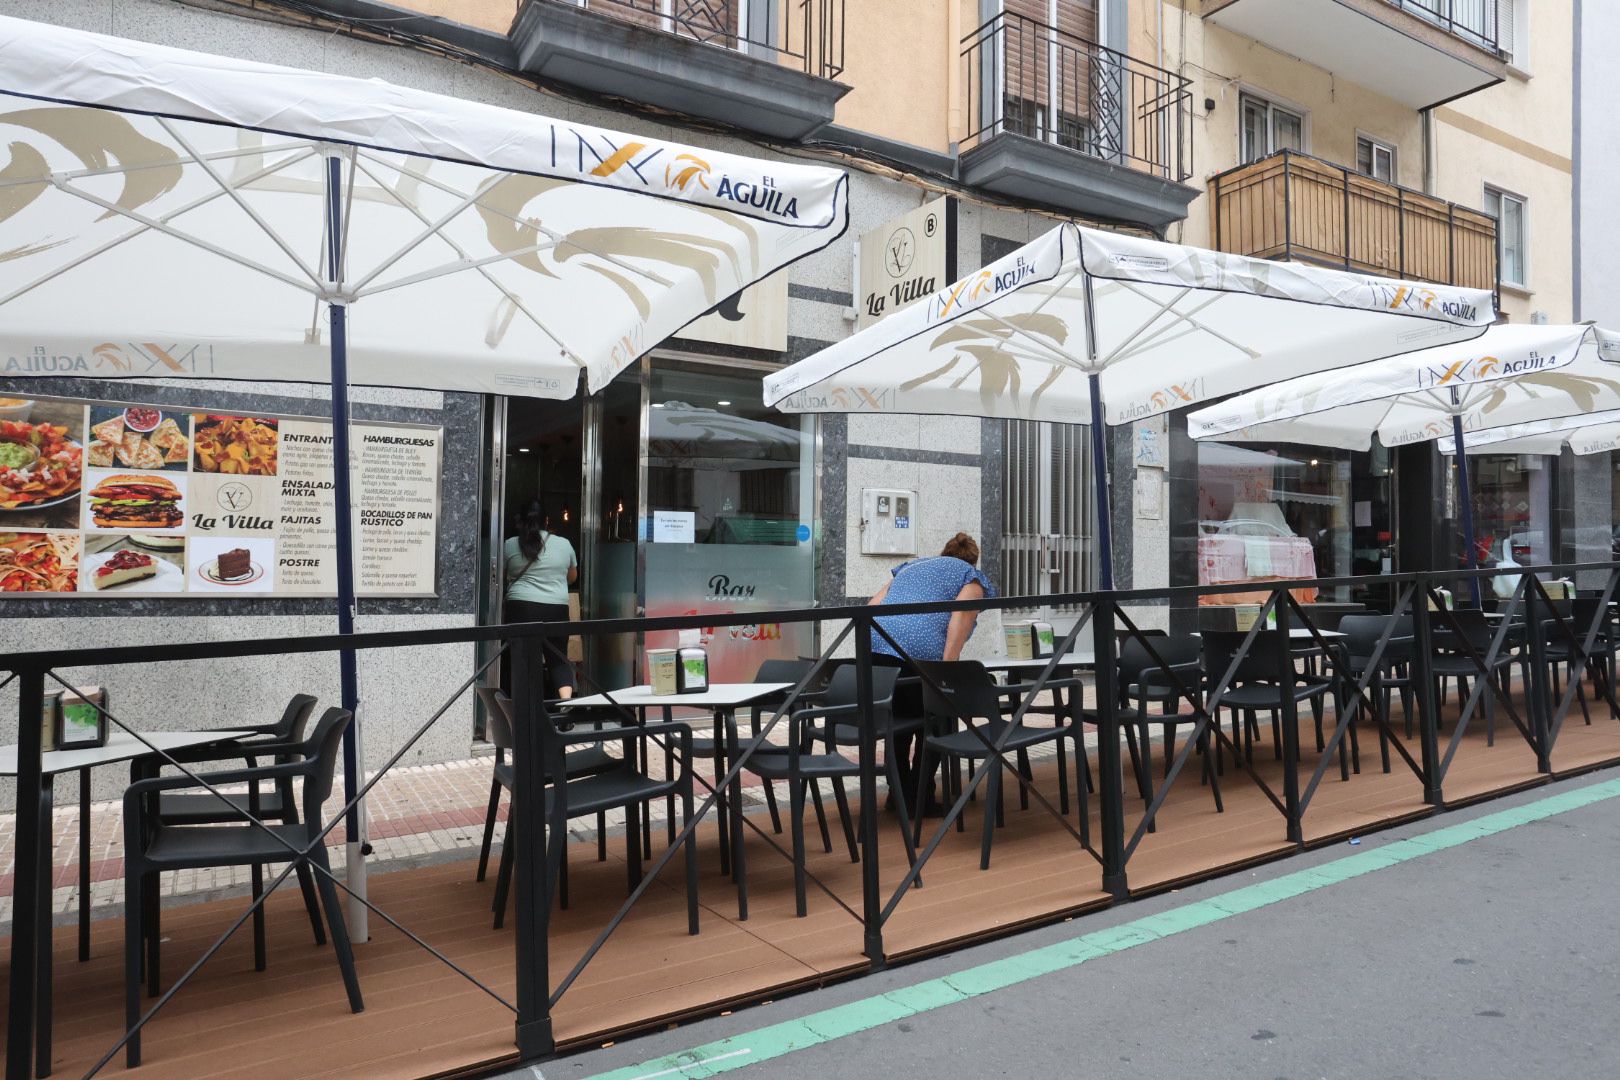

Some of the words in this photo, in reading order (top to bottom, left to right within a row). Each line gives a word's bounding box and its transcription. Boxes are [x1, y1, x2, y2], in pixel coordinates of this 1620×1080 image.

[762, 175, 777, 189] EL
[716, 174, 799, 219] ÁGUILA
[927, 218, 934, 233] B
[1017, 256, 1026, 267] EL
[866, 292, 885, 317] La
[890, 275, 936, 306] Villa
[283, 433, 334, 445] ENTRANT
[363, 434, 435, 447] HAMBURGUESAS
[281, 488, 316, 497] MIXTA
[280, 515, 322, 525] FAJITAS
[360, 509, 405, 519] BOCADILLOS
[406, 511, 416, 519] DE
[417, 511, 433, 520] PAN
[192, 513, 217, 531] La
[222, 514, 274, 530] Villa
[360, 518, 404, 527] RUSTICO
[279, 558, 320, 567] POSTRE
